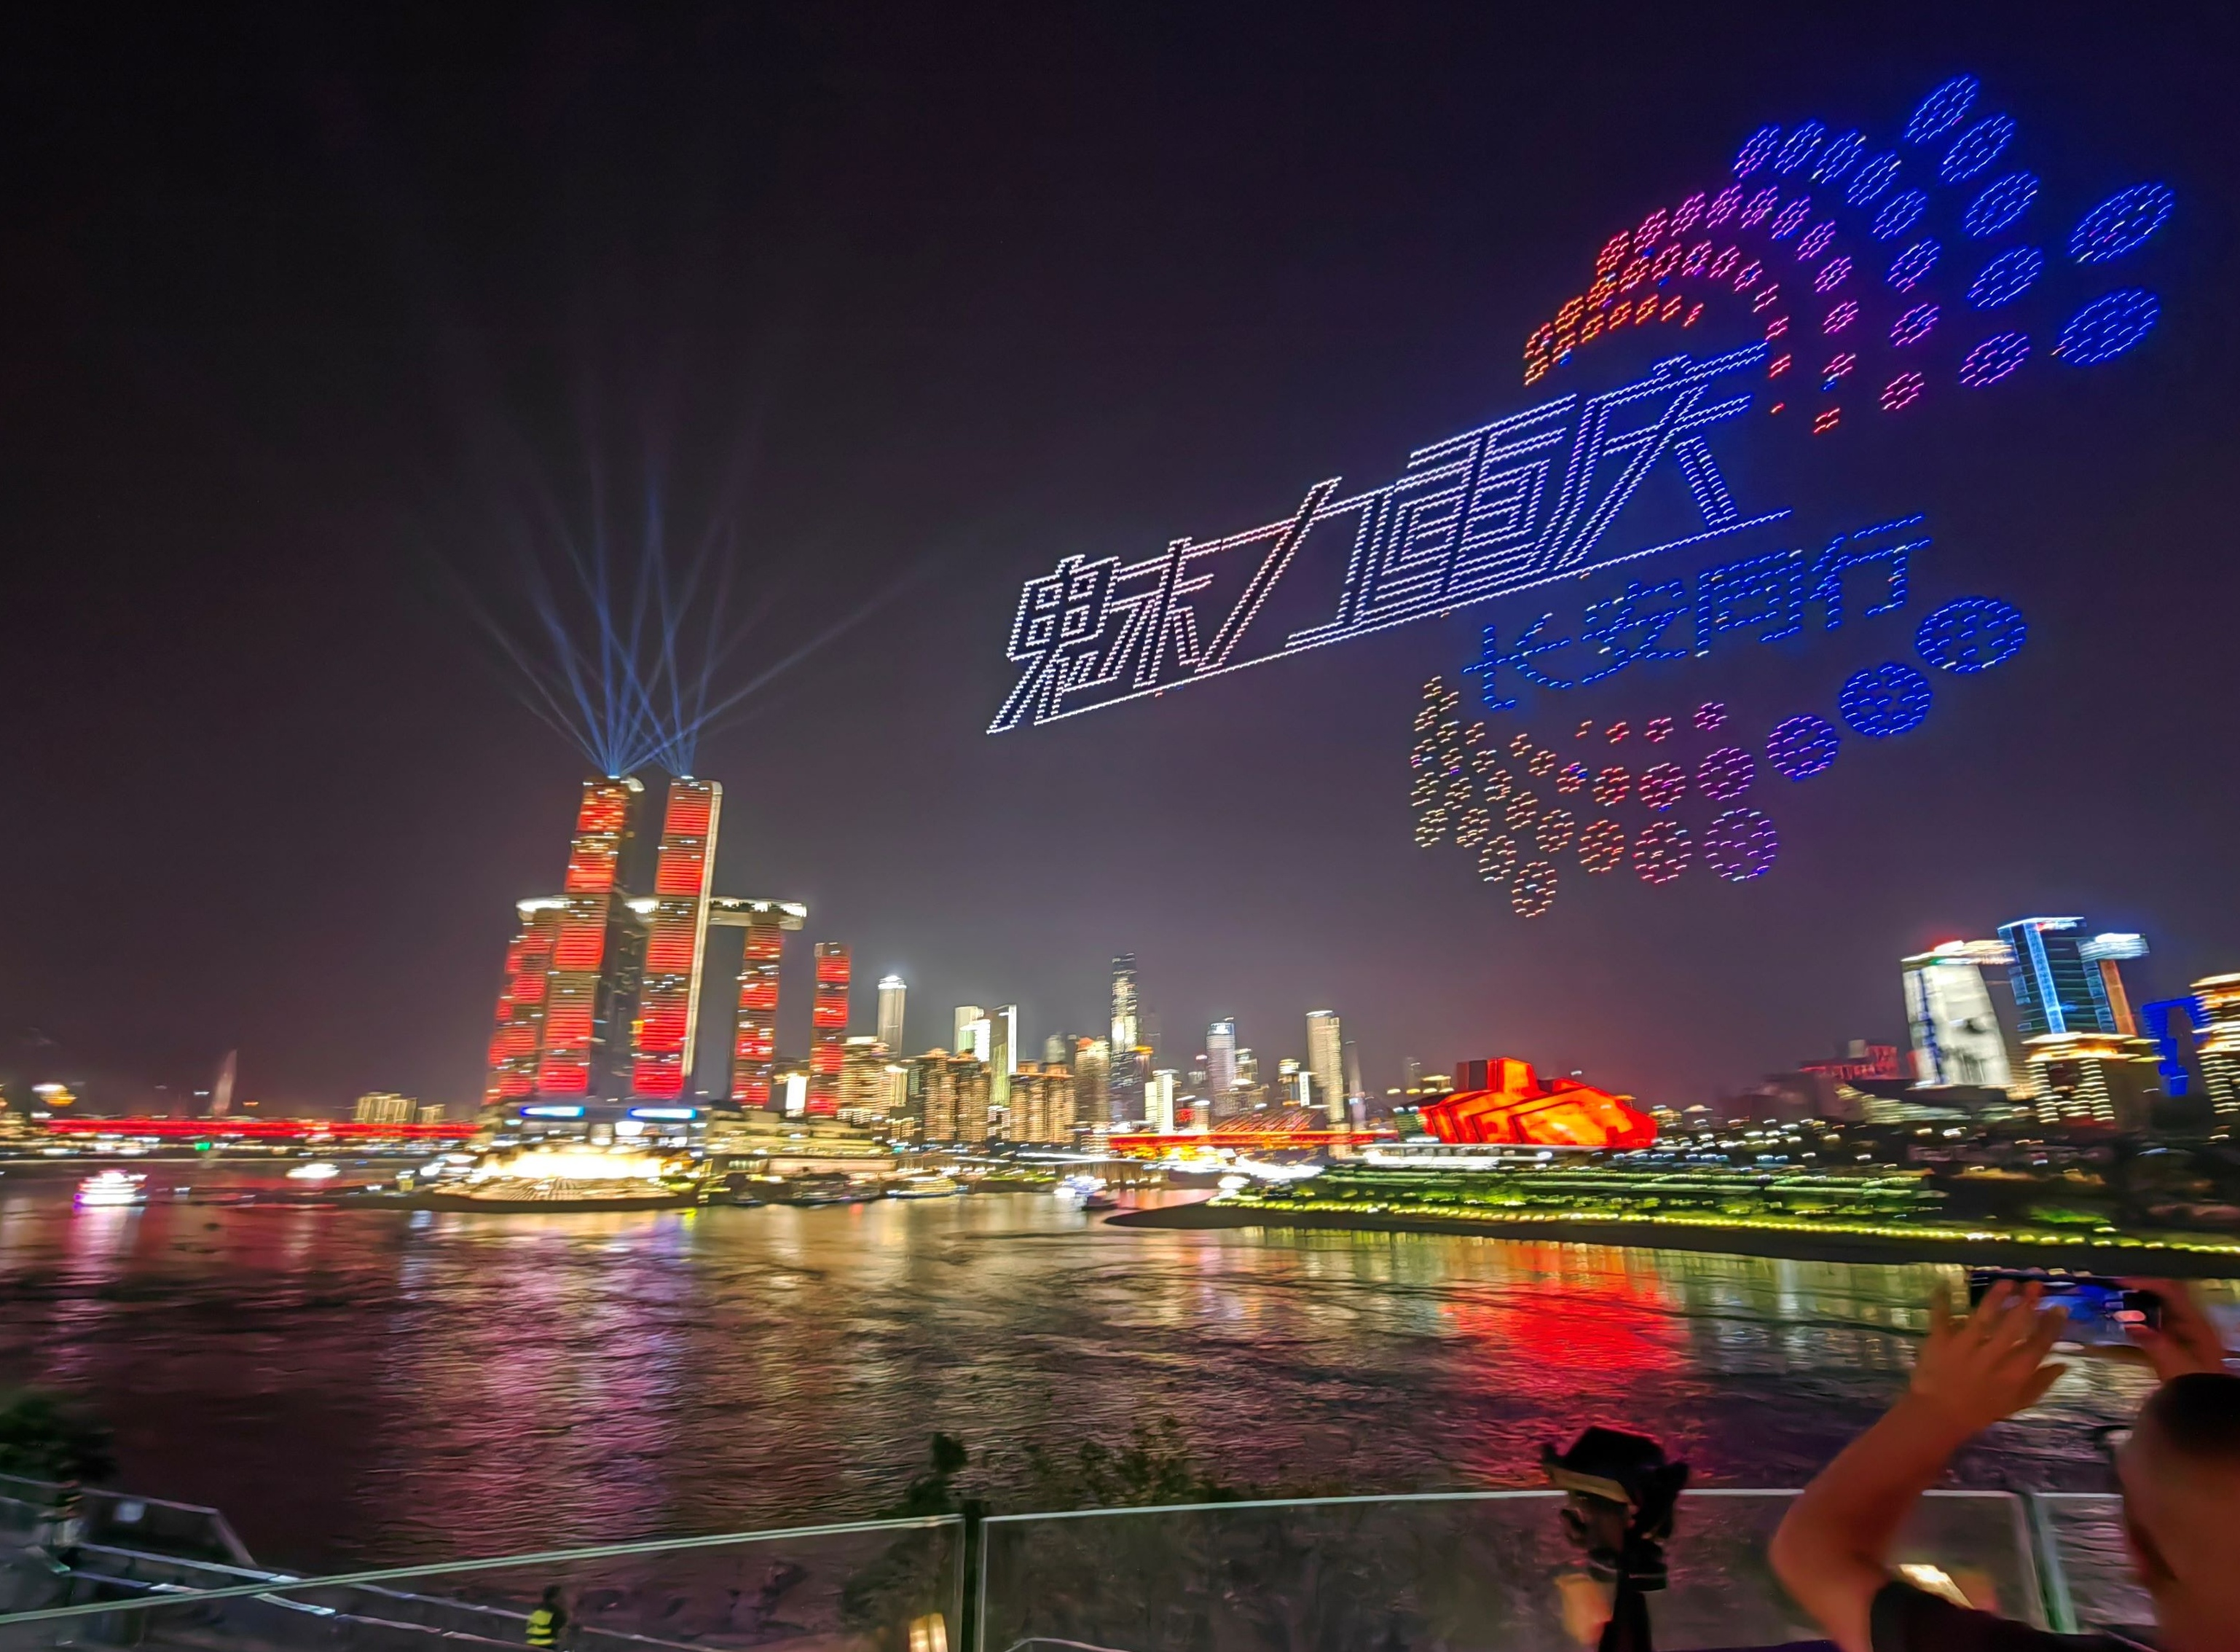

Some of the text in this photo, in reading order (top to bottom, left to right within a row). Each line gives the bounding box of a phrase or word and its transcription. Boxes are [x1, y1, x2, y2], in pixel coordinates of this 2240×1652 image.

[986, 342, 1792, 734] 魅力重庆
[1463, 513, 1932, 709] 长安同行
